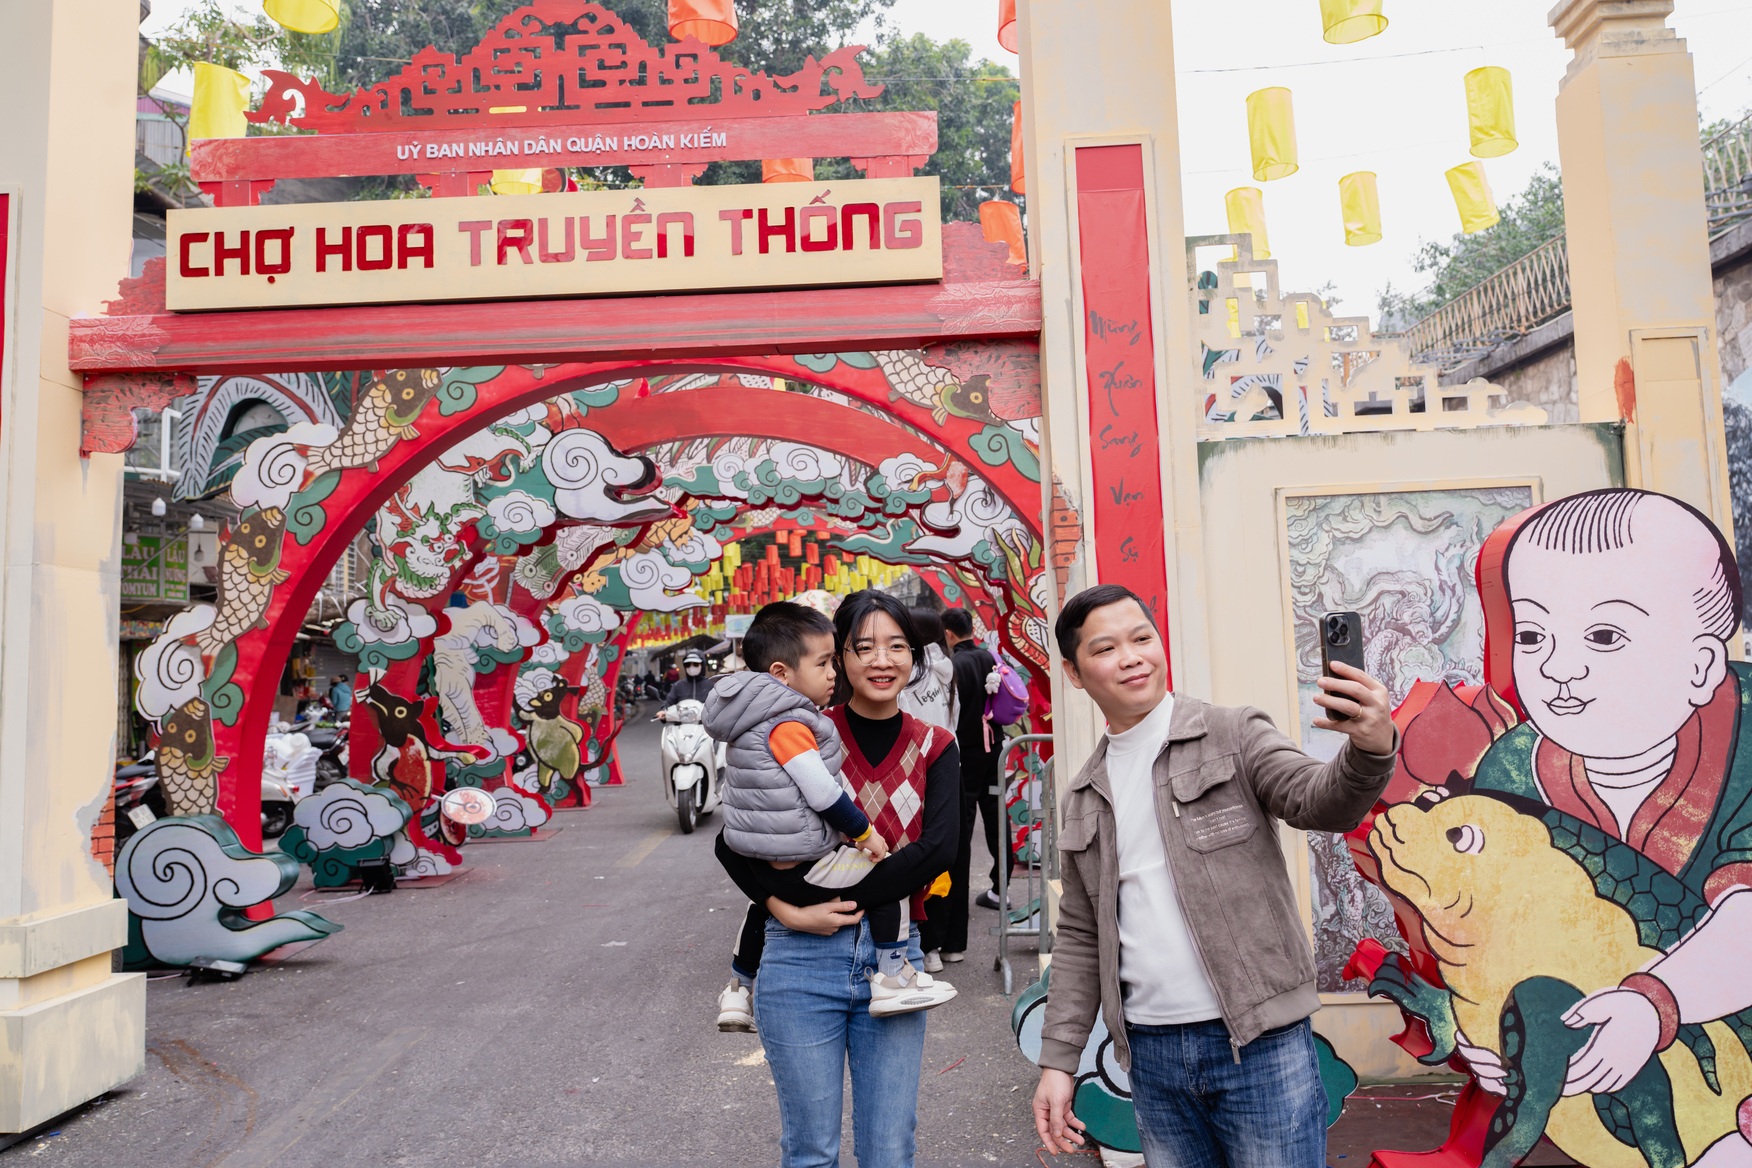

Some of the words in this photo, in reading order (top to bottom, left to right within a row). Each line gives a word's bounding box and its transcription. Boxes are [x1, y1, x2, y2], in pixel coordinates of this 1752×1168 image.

[397, 141, 422, 160] UỶ
[426, 143, 464, 158] BAN
[469, 138, 519, 157] NHÂN
[524, 136, 562, 155] DÂN
[567, 134, 618, 154] QUẬN
[623, 132, 675, 150] HOÀN
[680, 126, 727, 148] KIẾM
[180, 226, 294, 284] CHỢ
[316, 223, 434, 272] HOA
[458, 197, 695, 266] TRUYỀN
[719, 189, 923, 256] THỐNG
[1099, 424, 1145, 458] Sang
[1110, 477, 1144, 506] Vạn
